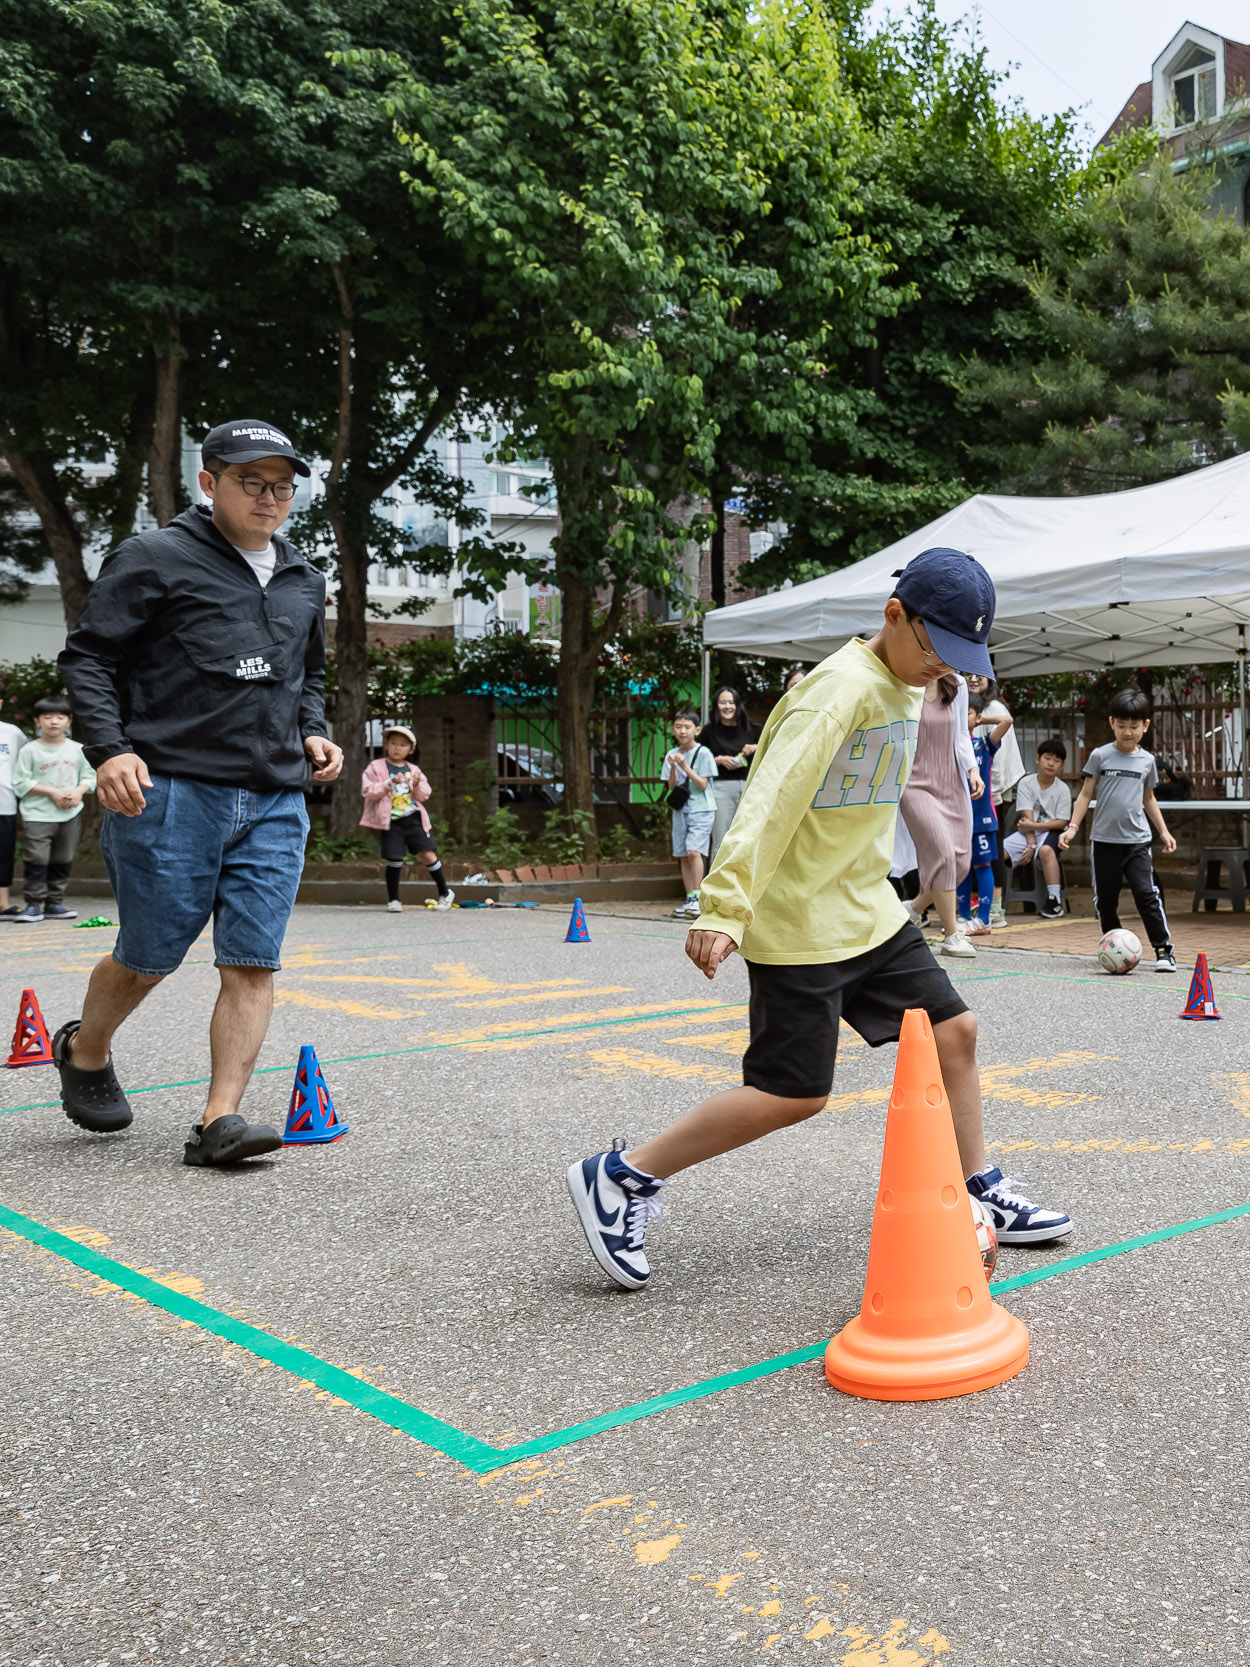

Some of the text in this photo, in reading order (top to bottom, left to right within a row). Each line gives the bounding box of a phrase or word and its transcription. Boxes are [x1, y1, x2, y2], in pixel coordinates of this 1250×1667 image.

[232, 427, 269, 437] MASTER
[239, 656, 264, 668] LES
[236, 663, 271, 677] MILLS
[978, 834, 989, 850] 5
